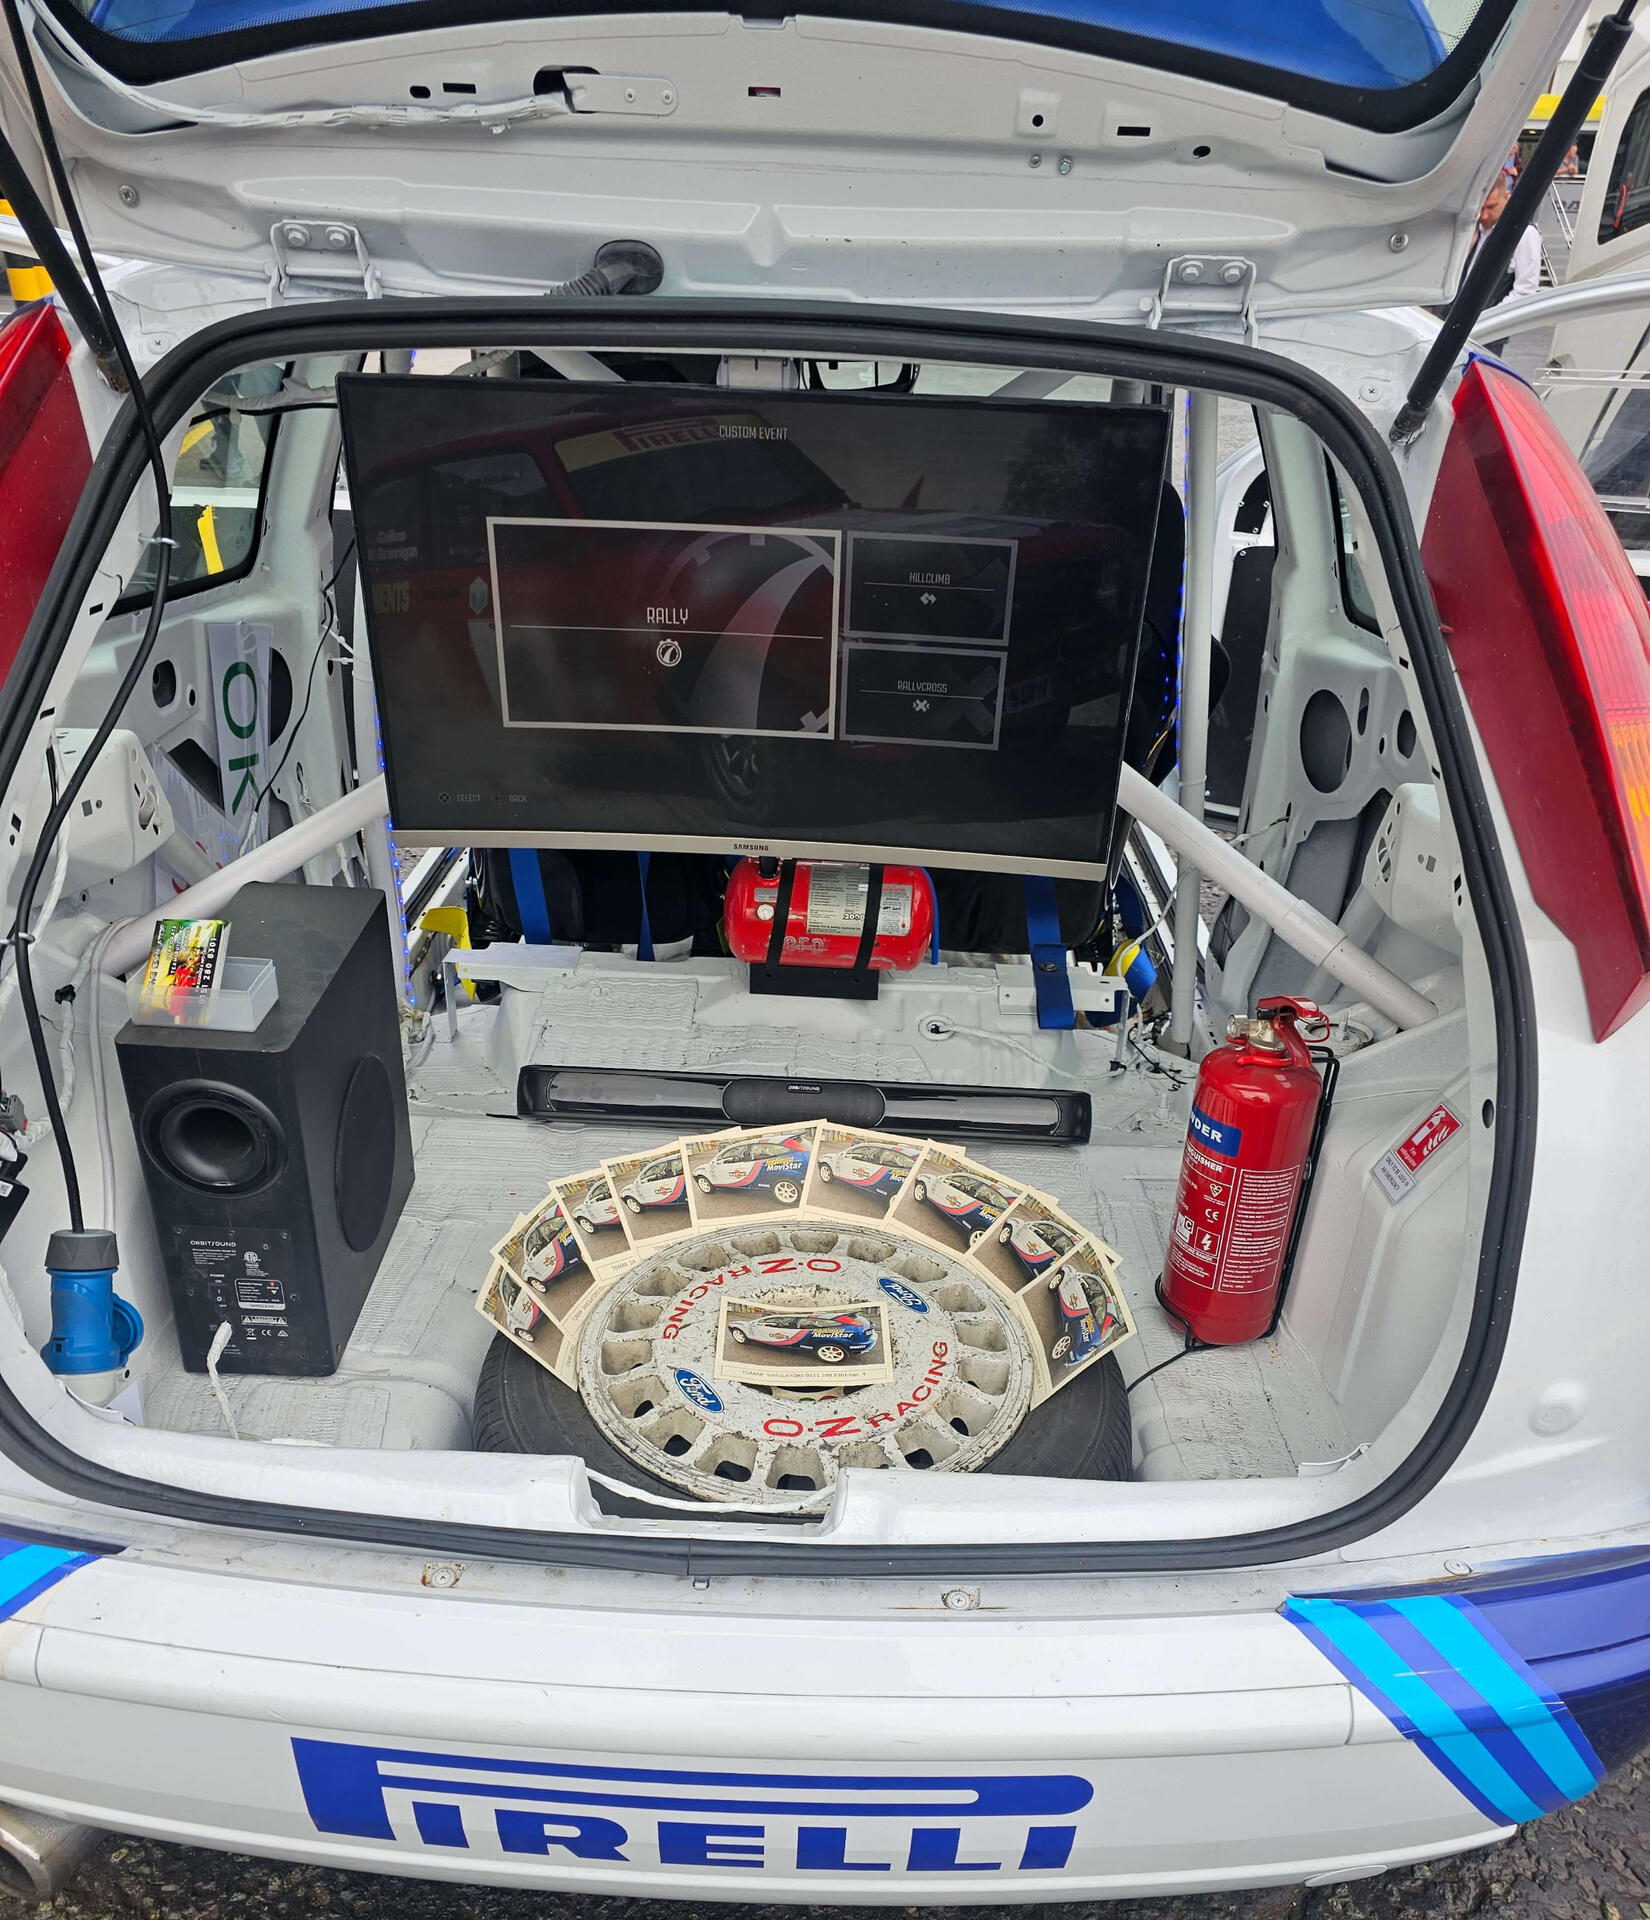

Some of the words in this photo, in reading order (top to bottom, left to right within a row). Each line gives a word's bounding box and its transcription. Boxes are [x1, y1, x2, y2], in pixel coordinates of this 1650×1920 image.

[718, 425, 752, 440] CUSTOM
[754, 426, 789, 441] EVENT
[908, 572, 951, 585] HILLCLIMB
[646, 607, 690, 626] RALLY
[896, 680, 949, 693] RALLYCROSS
[733, 843, 770, 852] SAMSUNG
[207, 937, 217, 959] 8301
[170, 956, 178, 974] TEAM
[203, 962, 213, 980] 280
[766, 1162, 803, 1172] MoviStar
[1385, 1157, 1394, 1167] ONLY
[1384, 1171, 1400, 1191] EMERGENCY
[663, 1264, 750, 1340] RACING
[884, 1282, 923, 1307] Ford
[812, 1330, 854, 1339] MoviStar
[680, 1376, 716, 1406] Ford
[869, 1341, 948, 1429] RACING
[291, 1737, 1094, 1871] PIRELLI
